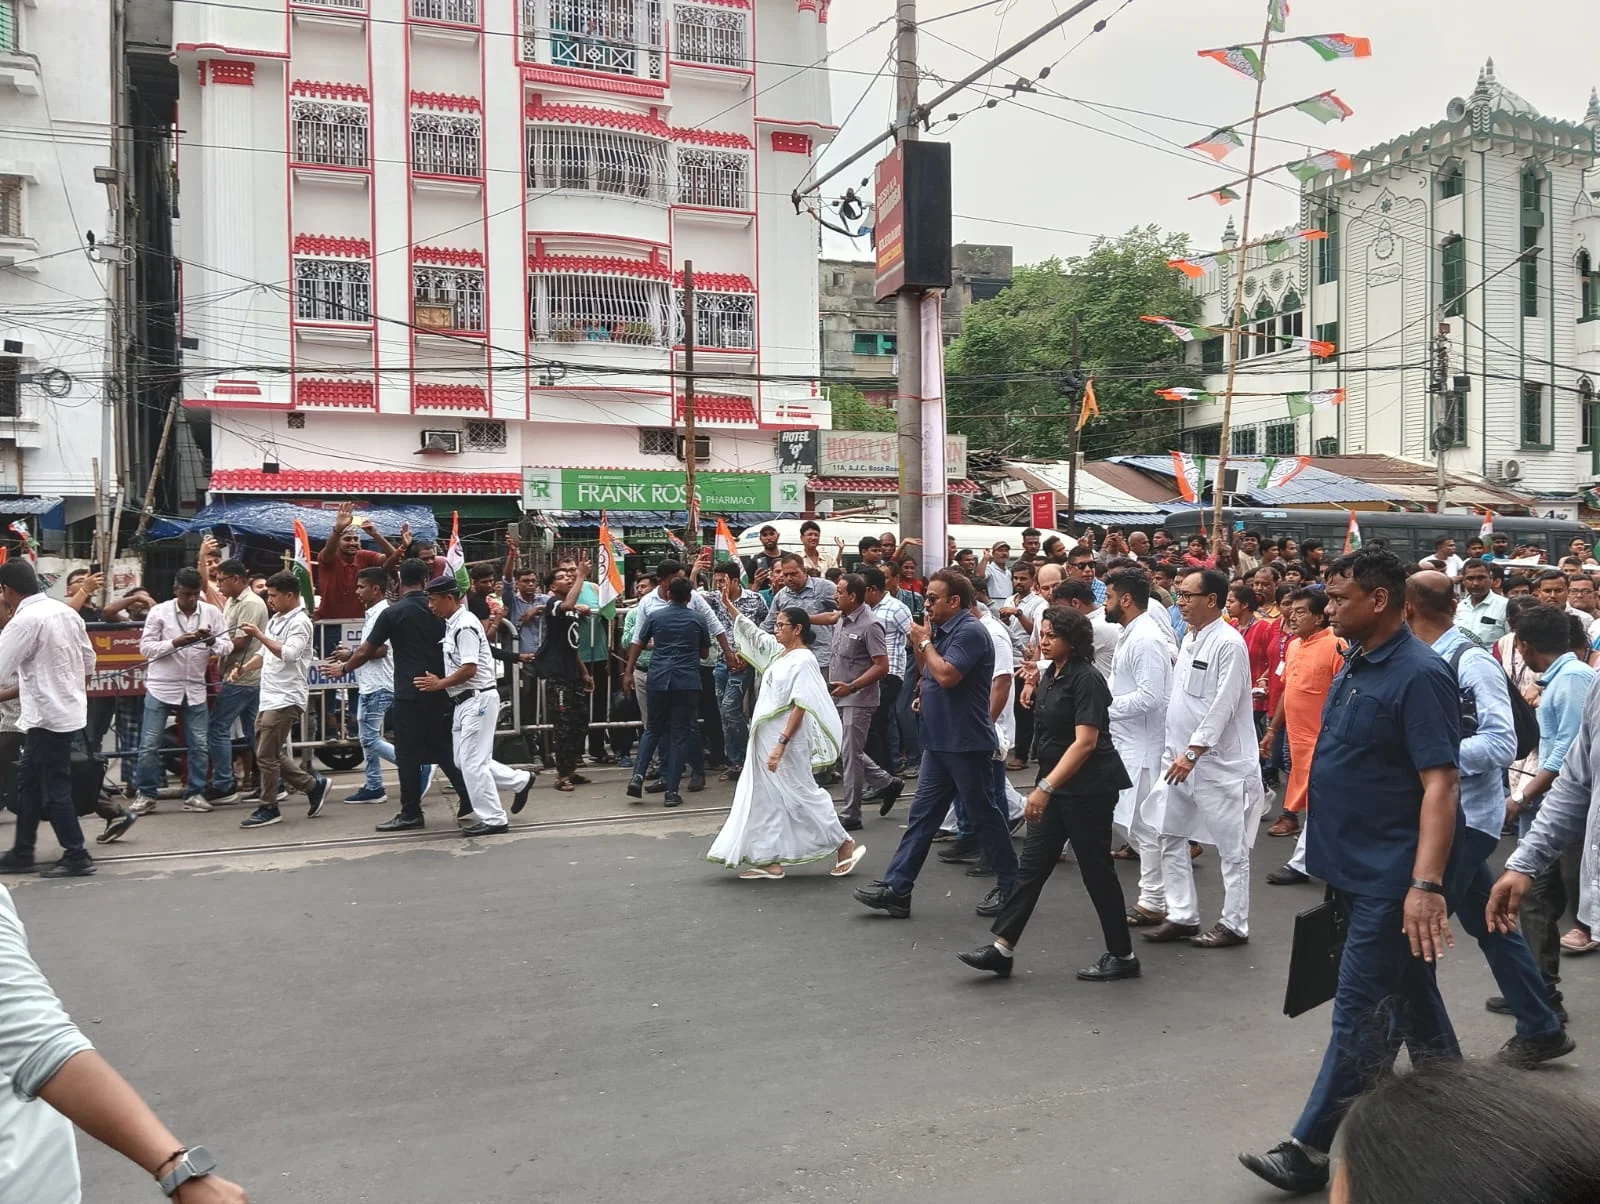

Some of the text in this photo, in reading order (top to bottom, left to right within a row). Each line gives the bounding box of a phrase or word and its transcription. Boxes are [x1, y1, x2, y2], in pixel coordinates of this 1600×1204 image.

[782, 431, 810, 442] HOTEL
[826, 437, 877, 461] HOTEL
[578, 483, 756, 505] FRANK ROSS PHARMACY
